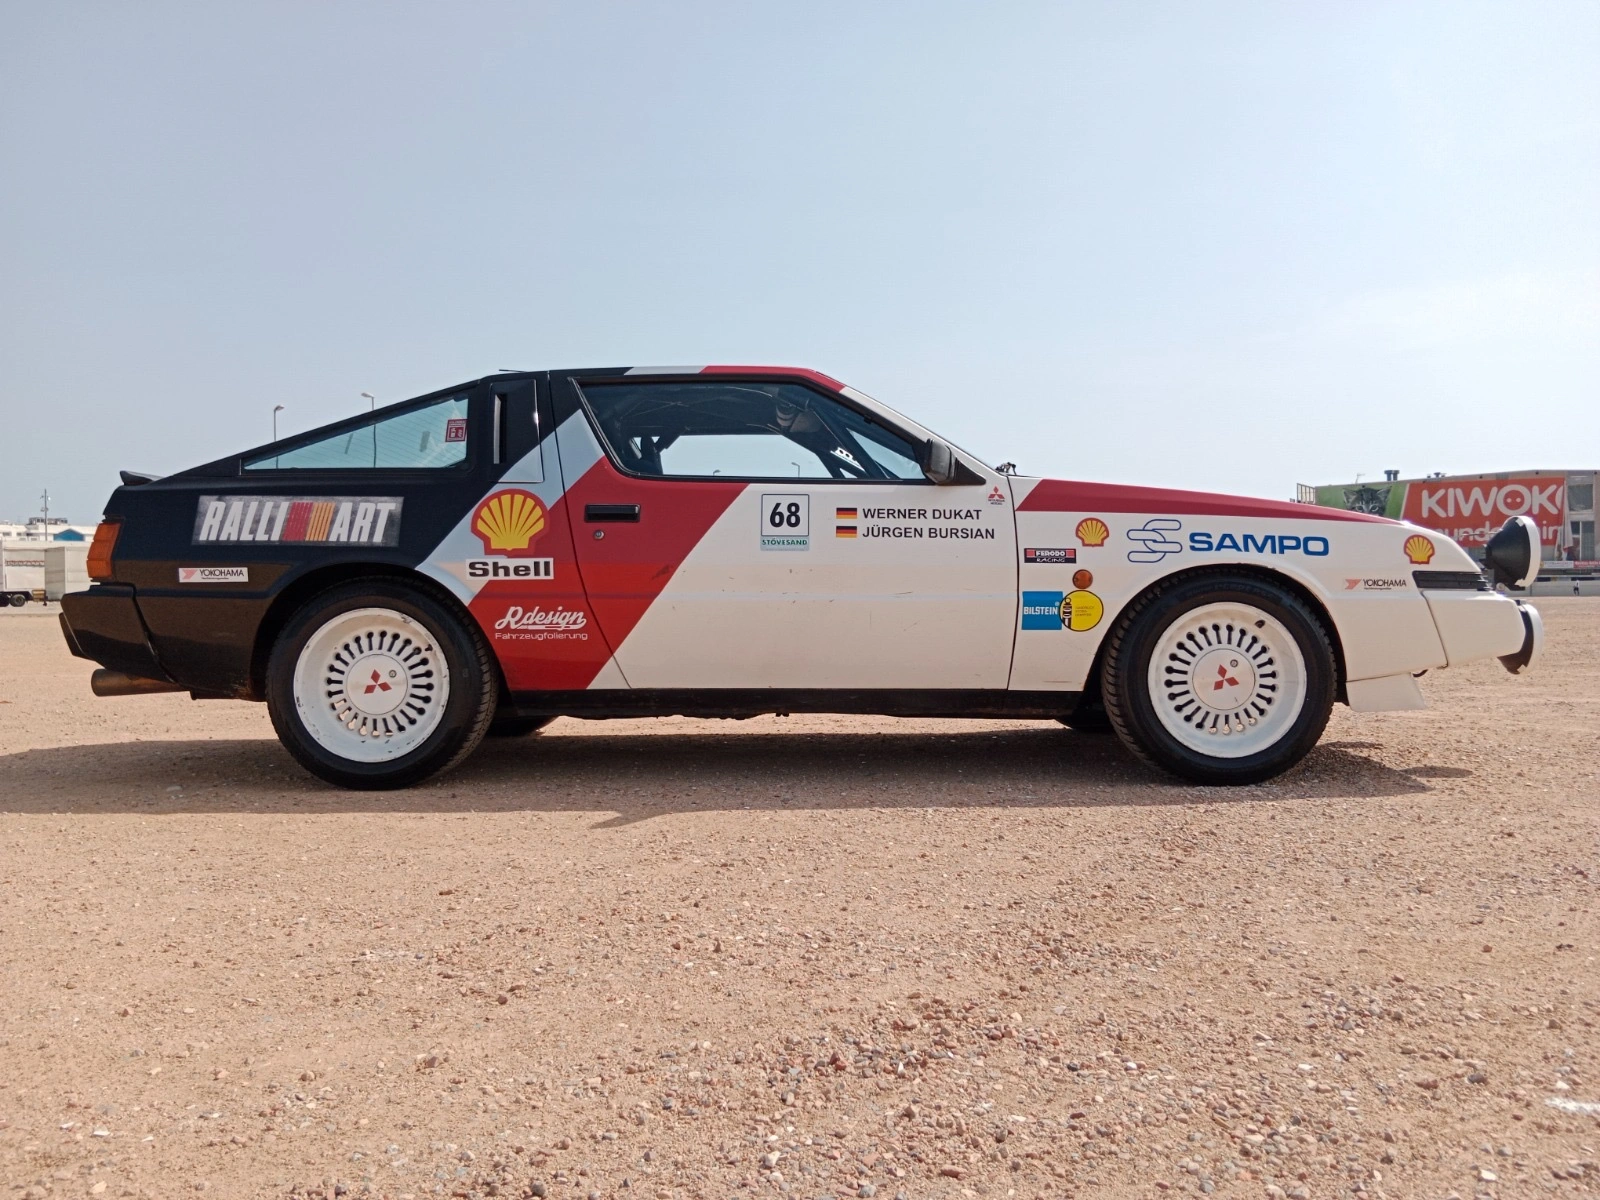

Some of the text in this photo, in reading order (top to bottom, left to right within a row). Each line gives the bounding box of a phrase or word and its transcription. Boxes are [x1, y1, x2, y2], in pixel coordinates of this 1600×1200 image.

[1421, 484, 1563, 518] KIWOK
[769, 502, 801, 528] 68
[862, 508, 983, 520] WERNER DUKAT
[199, 501, 396, 542] RALLI ART
[862, 524, 996, 540] JÜRGEN BURSIAN
[762, 537, 808, 546] STÖVESAND
[1189, 532, 1329, 557] SAMPO
[200, 568, 245, 577] YOKOHAMA
[468, 561, 551, 577] Shell
[1363, 578, 1407, 587] YOKOHAMA
[1023, 606, 1059, 615] BILSTEIN
[495, 632, 588, 640] Fahrzeugfolierung
